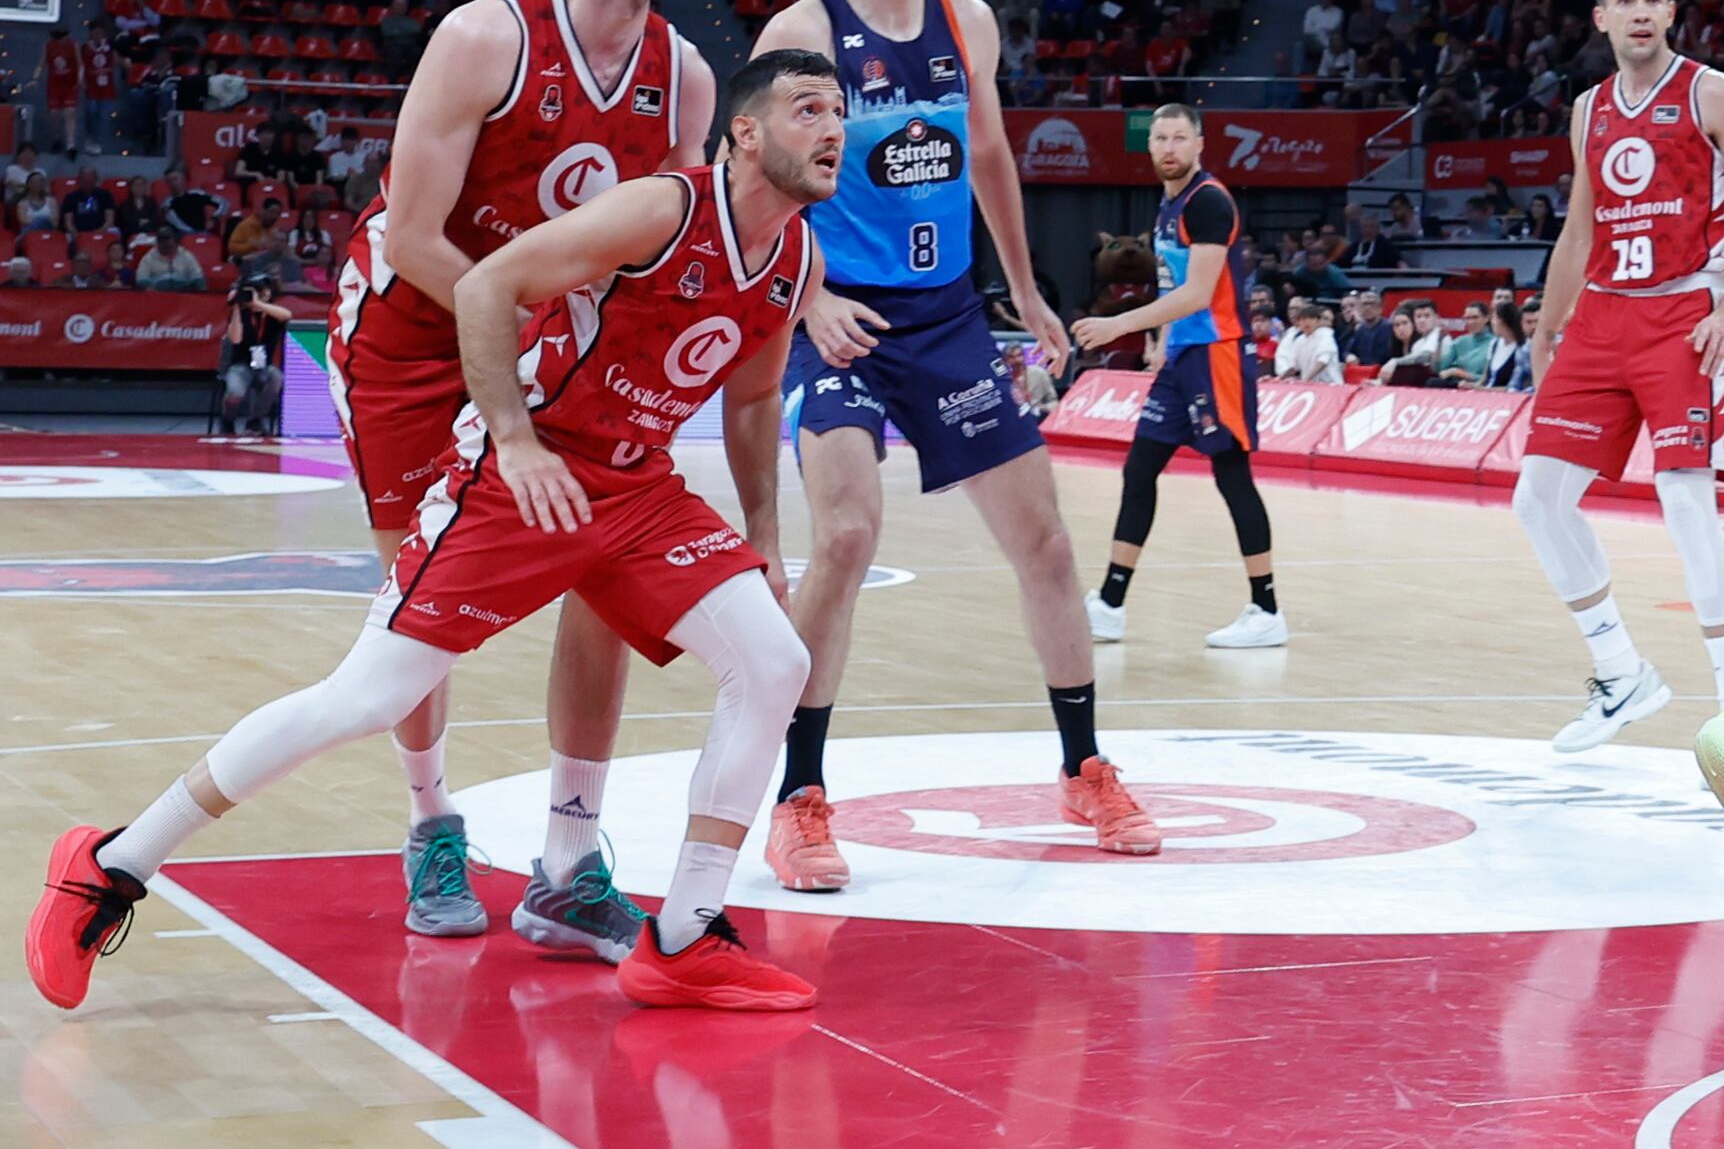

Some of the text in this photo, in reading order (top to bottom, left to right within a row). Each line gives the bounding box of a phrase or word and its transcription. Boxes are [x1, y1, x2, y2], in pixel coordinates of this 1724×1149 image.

[884, 139, 953, 165] Estrella
[886, 161, 950, 184] Galicia
[1595, 197, 1684, 223] Csademont
[909, 222, 938, 272] 8
[101, 320, 213, 340] Casademont
[1388, 404, 1510, 444] SUGRAF
